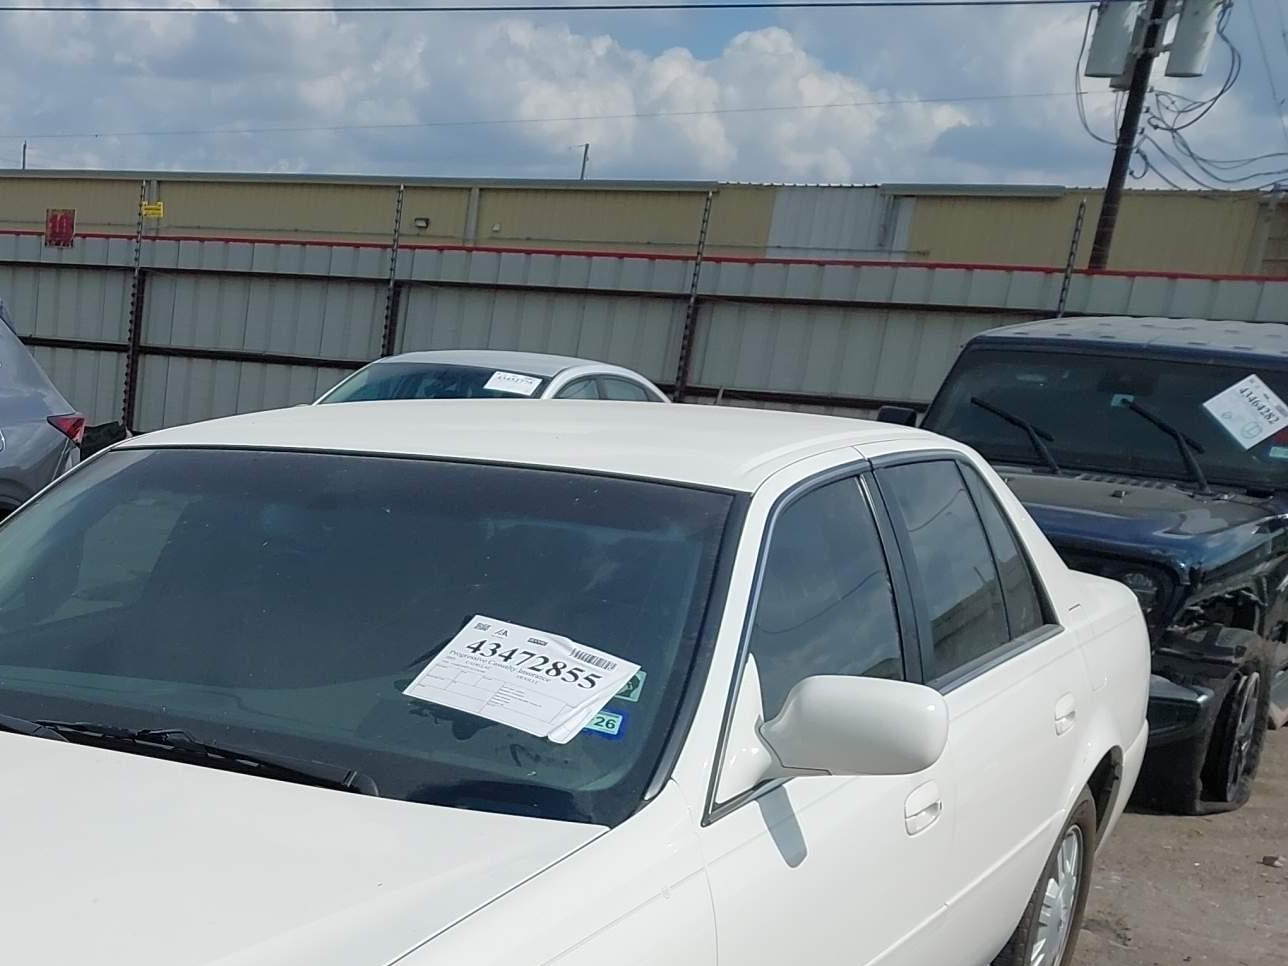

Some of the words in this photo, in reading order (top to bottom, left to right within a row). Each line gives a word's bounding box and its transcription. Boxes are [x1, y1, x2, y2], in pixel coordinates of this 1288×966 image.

[449, 650, 488, 663] Progressive
[488, 660, 516, 672] Casualty
[518, 667, 552, 682] Insurance
[466, 639, 602, 689] 43472855
[593, 716, 617, 729] 26
